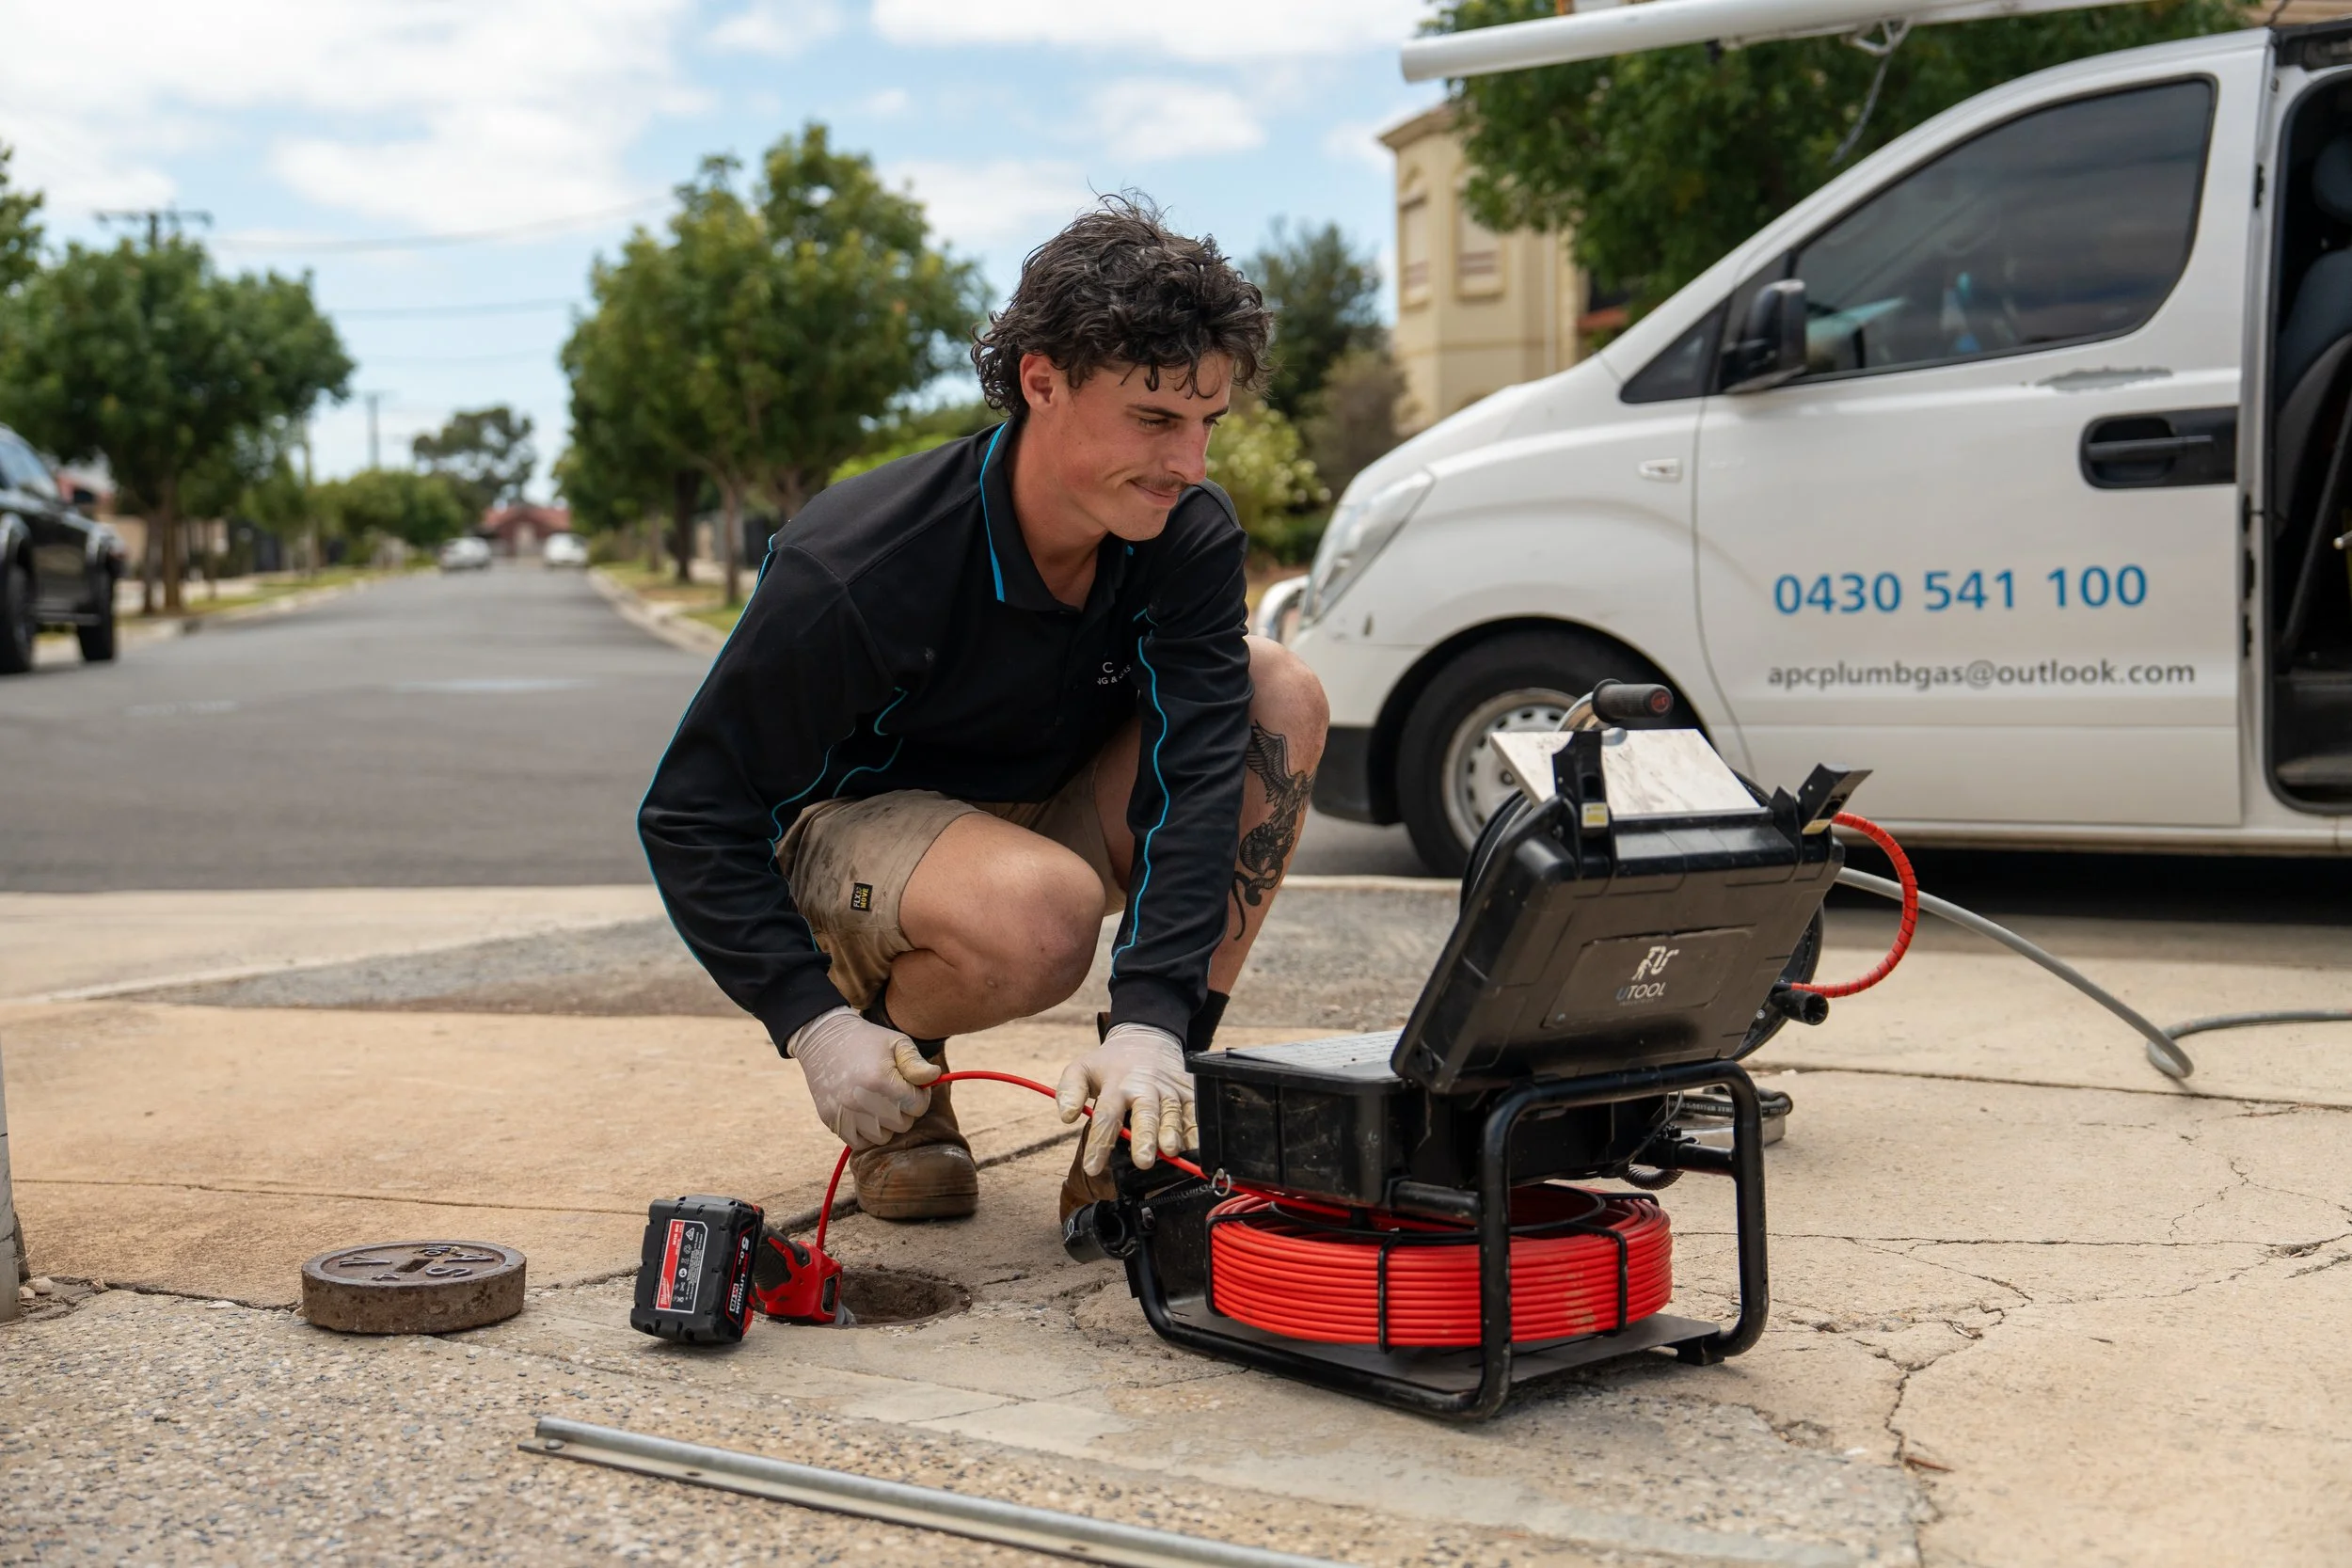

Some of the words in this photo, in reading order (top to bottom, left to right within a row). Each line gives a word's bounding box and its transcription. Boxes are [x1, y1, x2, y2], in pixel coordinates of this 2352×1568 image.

[1774, 572, 1901, 614] 0430
[1924, 569, 2013, 611] 541
[2047, 565, 2148, 609] 100
[1768, 659, 2196, 691] apcplumbgas@outlook.com
[860, 888, 869, 909] MOVE
